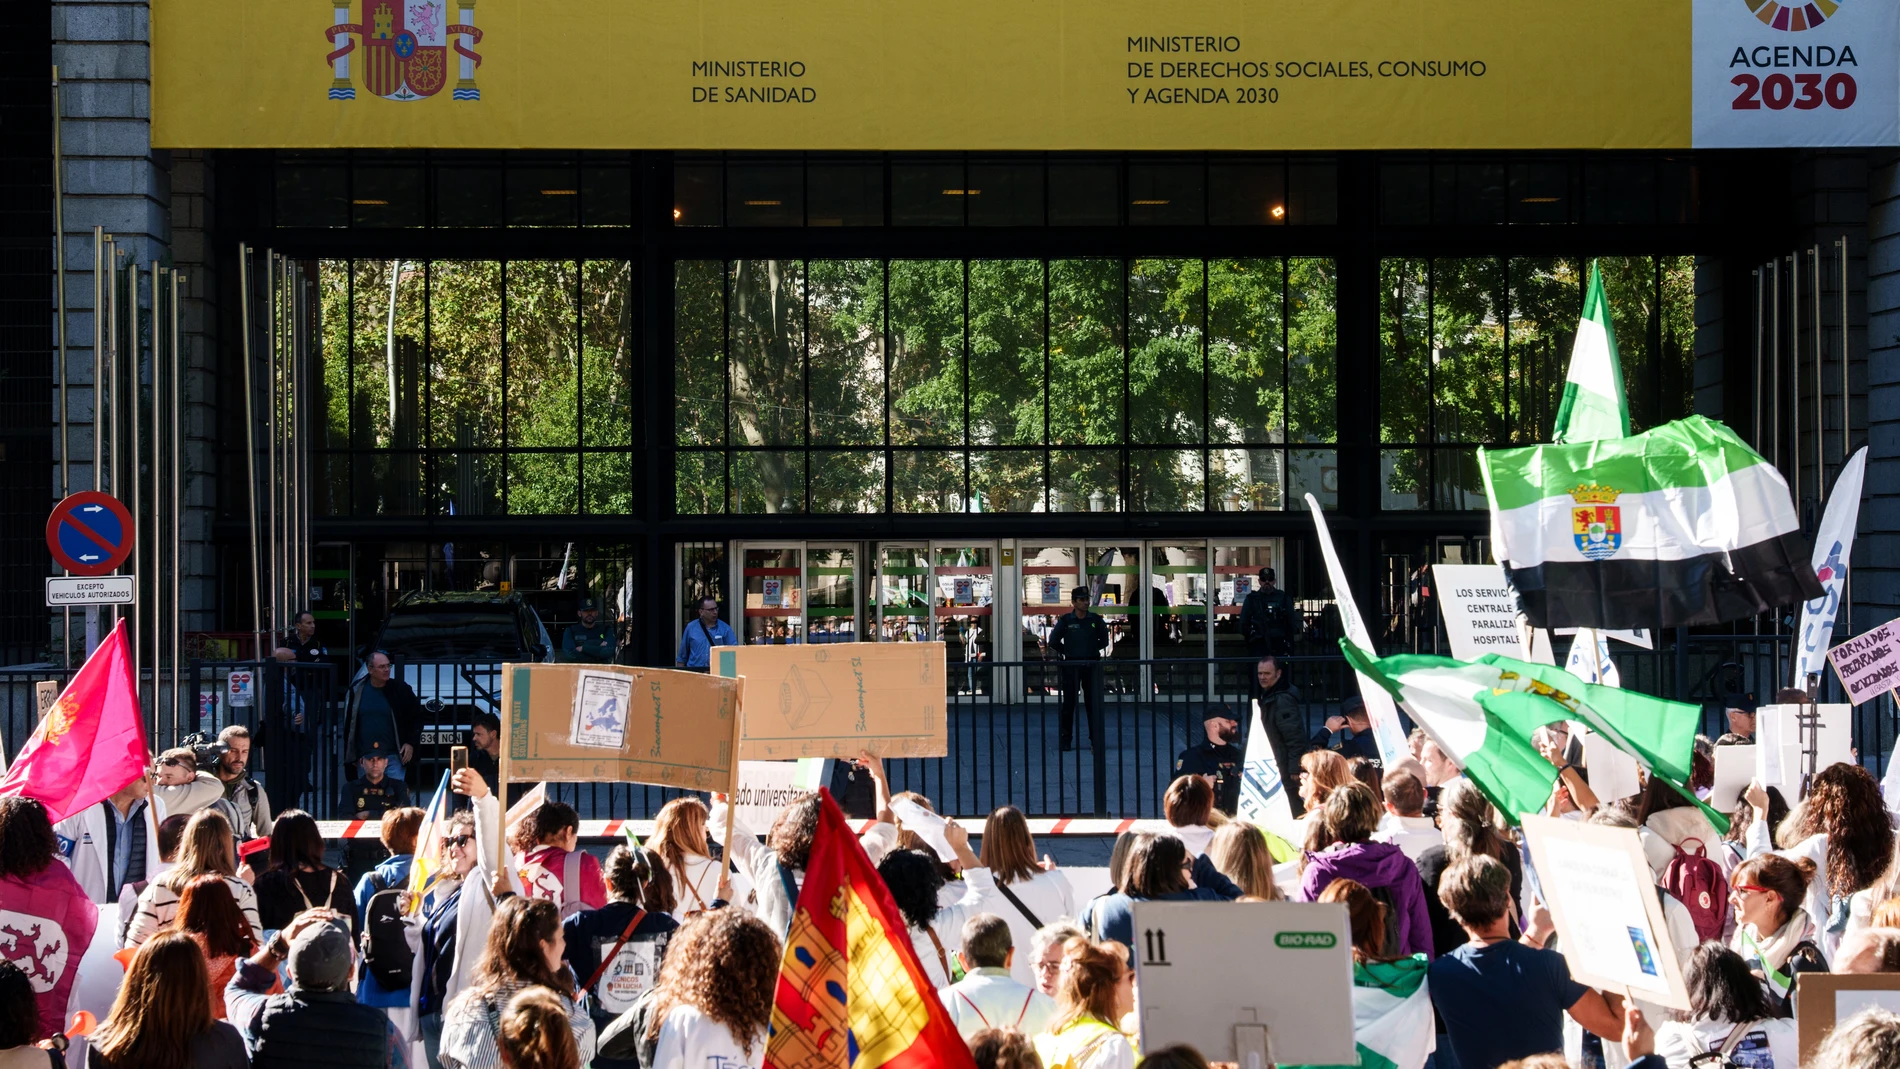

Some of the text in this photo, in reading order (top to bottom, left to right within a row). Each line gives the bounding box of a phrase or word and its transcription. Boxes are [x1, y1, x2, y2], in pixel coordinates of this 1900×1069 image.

[1127, 35, 1241, 53] MINISTERIO
[1730, 45, 1858, 68] AGENDA
[692, 60, 806, 78] MINISTERIO
[1127, 60, 1487, 81] DE DERECHOS SOCIALES, CONSUMO
[692, 86, 817, 103] DE SANIDAD
[1126, 87, 1279, 104] Y AGENDA 2030
[1730, 72, 1858, 111] 2030
[87, 590, 130, 598] AUTORIZADOS
[1456, 588, 1509, 598] LOS SERVICI
[1467, 604, 1513, 613] CENTRALE
[1472, 620, 1516, 628] PARALIZA
[1473, 635, 1520, 644] HOSPITALE
[1832, 626, 1895, 663] FORMADOS,
[512, 701, 521, 758] MEDICAL WASTE
[519, 719, 528, 758] SOLUTIONS
